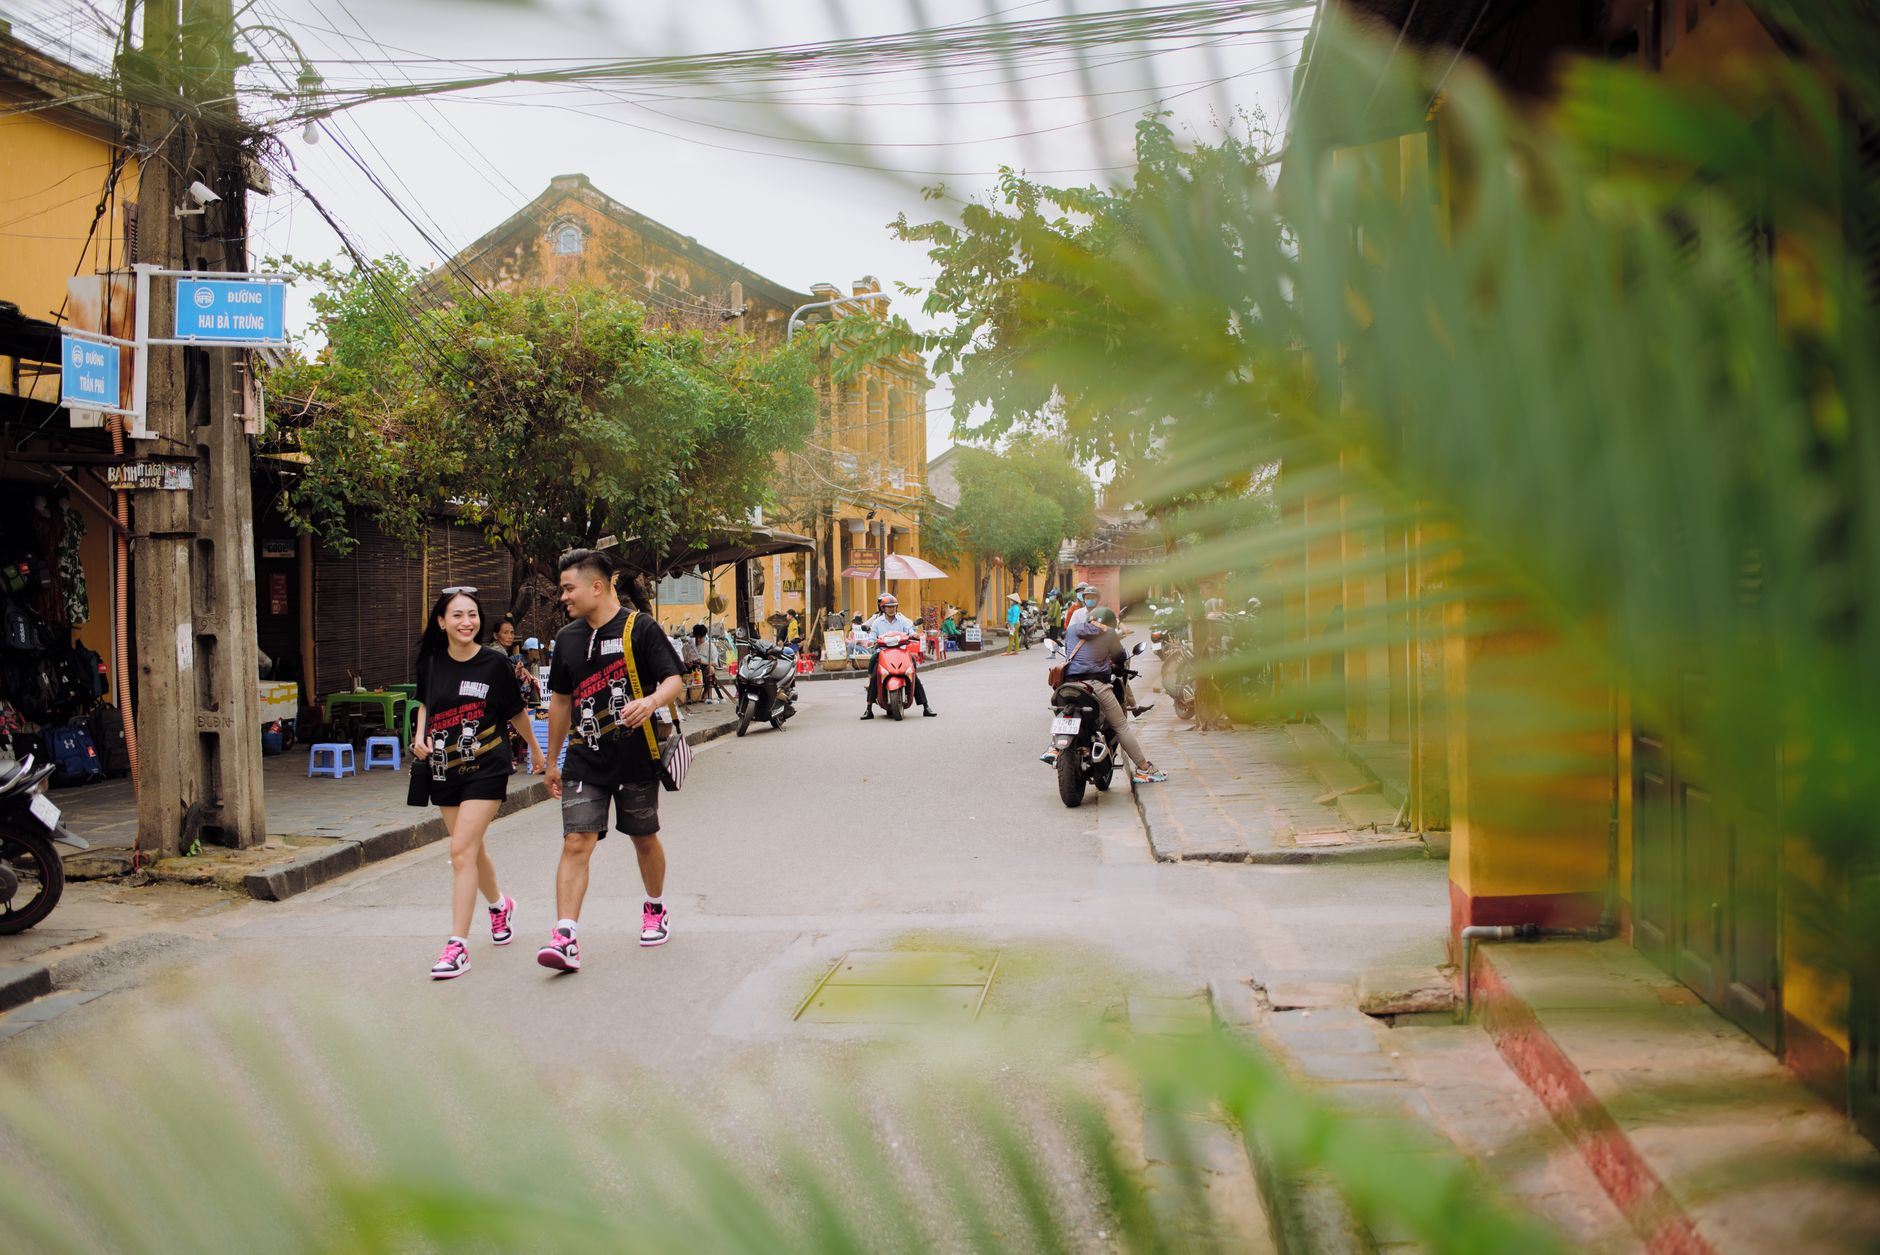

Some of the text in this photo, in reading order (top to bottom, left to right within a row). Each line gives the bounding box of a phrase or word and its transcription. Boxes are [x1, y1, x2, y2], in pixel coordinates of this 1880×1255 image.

[228, 289, 262, 304] ĐƯỜNG
[198, 312, 264, 330] HAI BÀ TRƯNG
[85, 351, 104, 367] ĐƯỜNG
[95, 376, 104, 394] PHÚ
[783, 579, 804, 591] ATM
